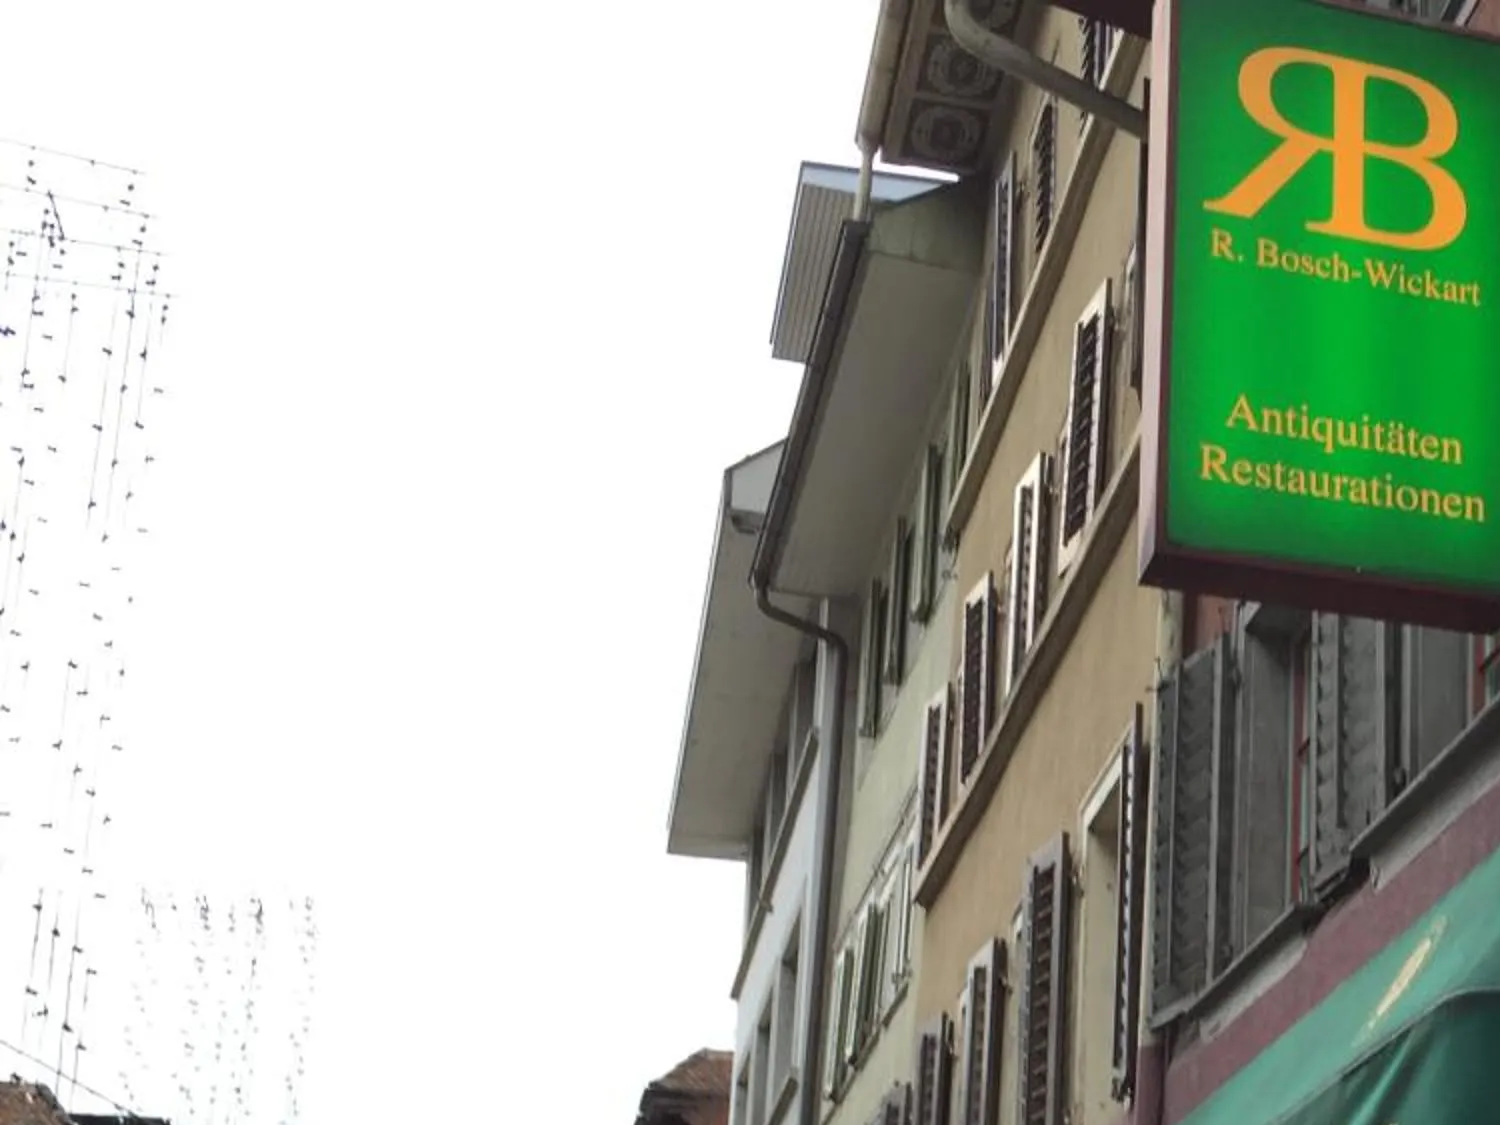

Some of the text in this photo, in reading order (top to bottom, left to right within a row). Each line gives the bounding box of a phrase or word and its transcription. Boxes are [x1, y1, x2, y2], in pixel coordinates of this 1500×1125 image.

[1210, 229, 1482, 307] R. Bosch-Wickart
[1225, 394, 1464, 465] Antiquitäten
[1199, 444, 1487, 522] Restaurationen
